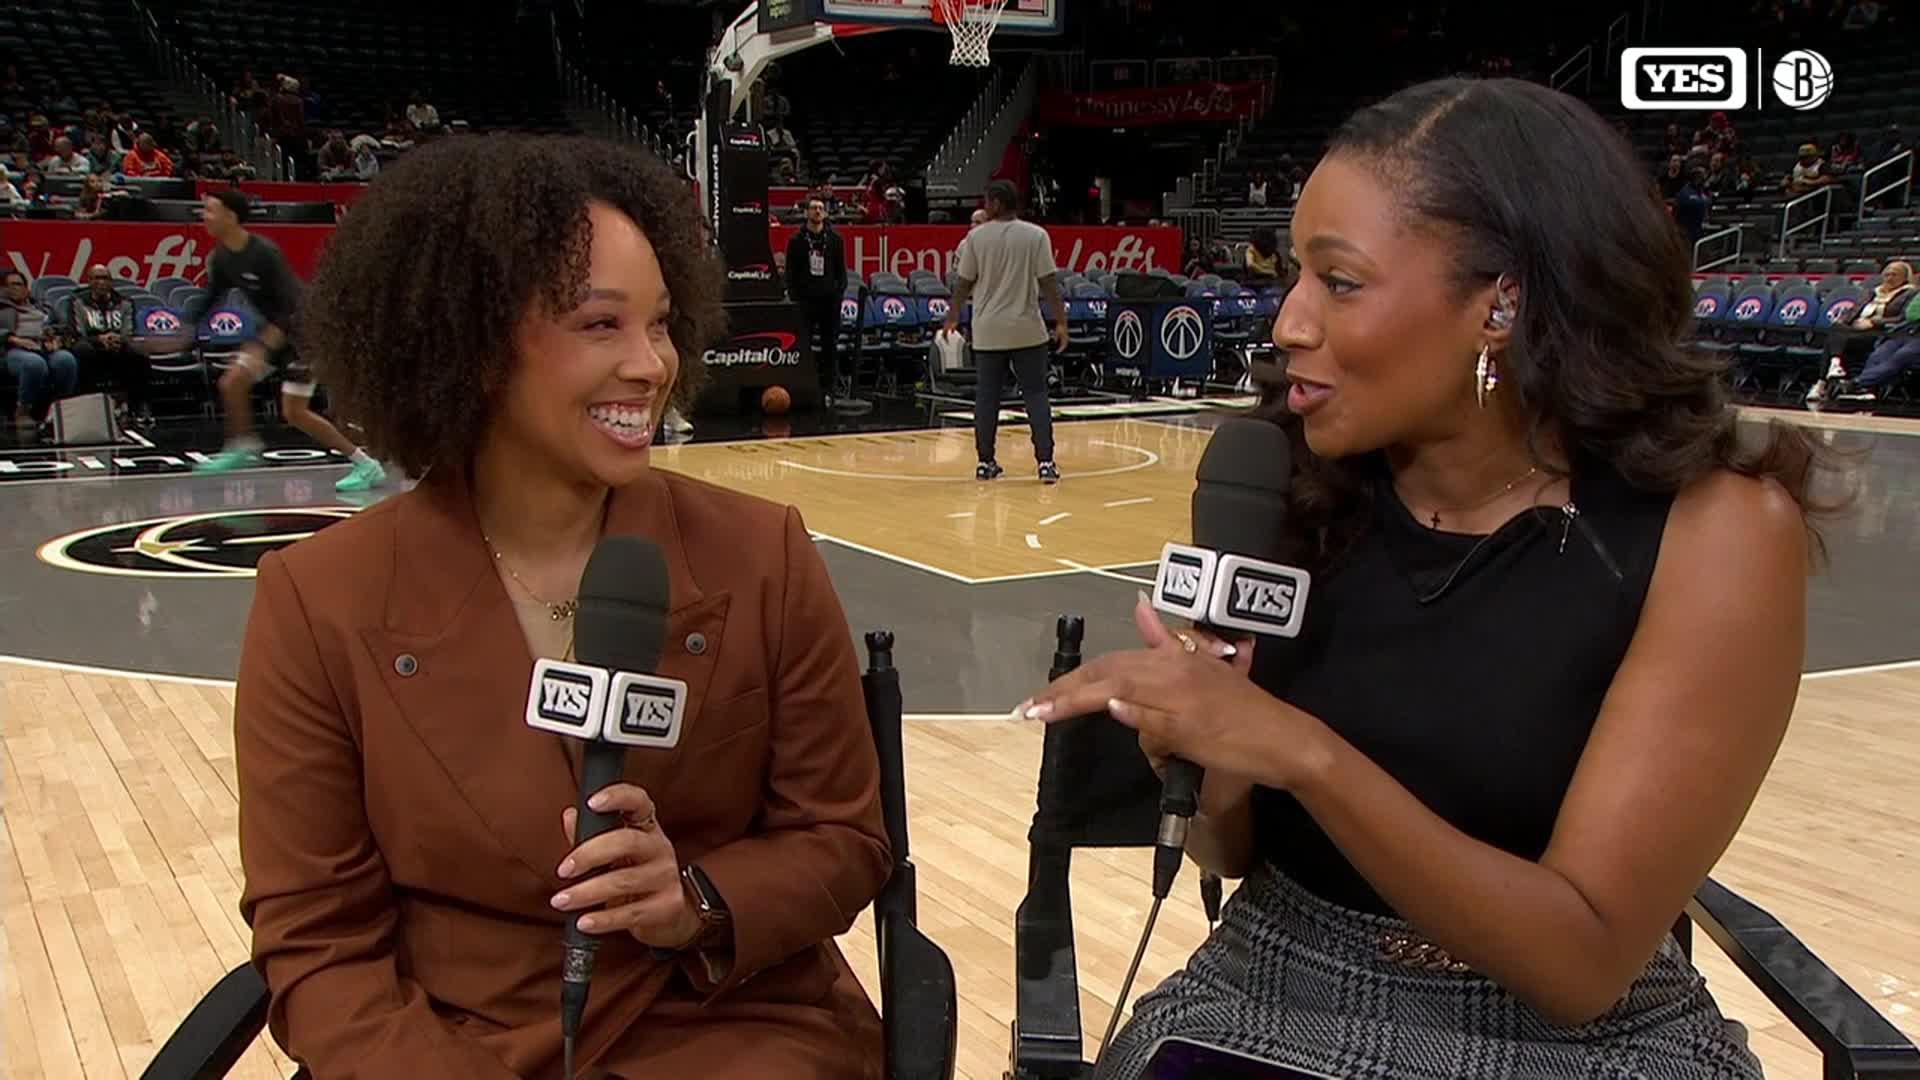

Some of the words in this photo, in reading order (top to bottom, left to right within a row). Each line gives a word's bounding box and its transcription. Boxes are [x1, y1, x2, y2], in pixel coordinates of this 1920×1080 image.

[1164, 562, 1201, 600] YES
[1235, 576, 1295, 618] YES
[542, 677, 592, 718] YES
[626, 691, 675, 730] YES
